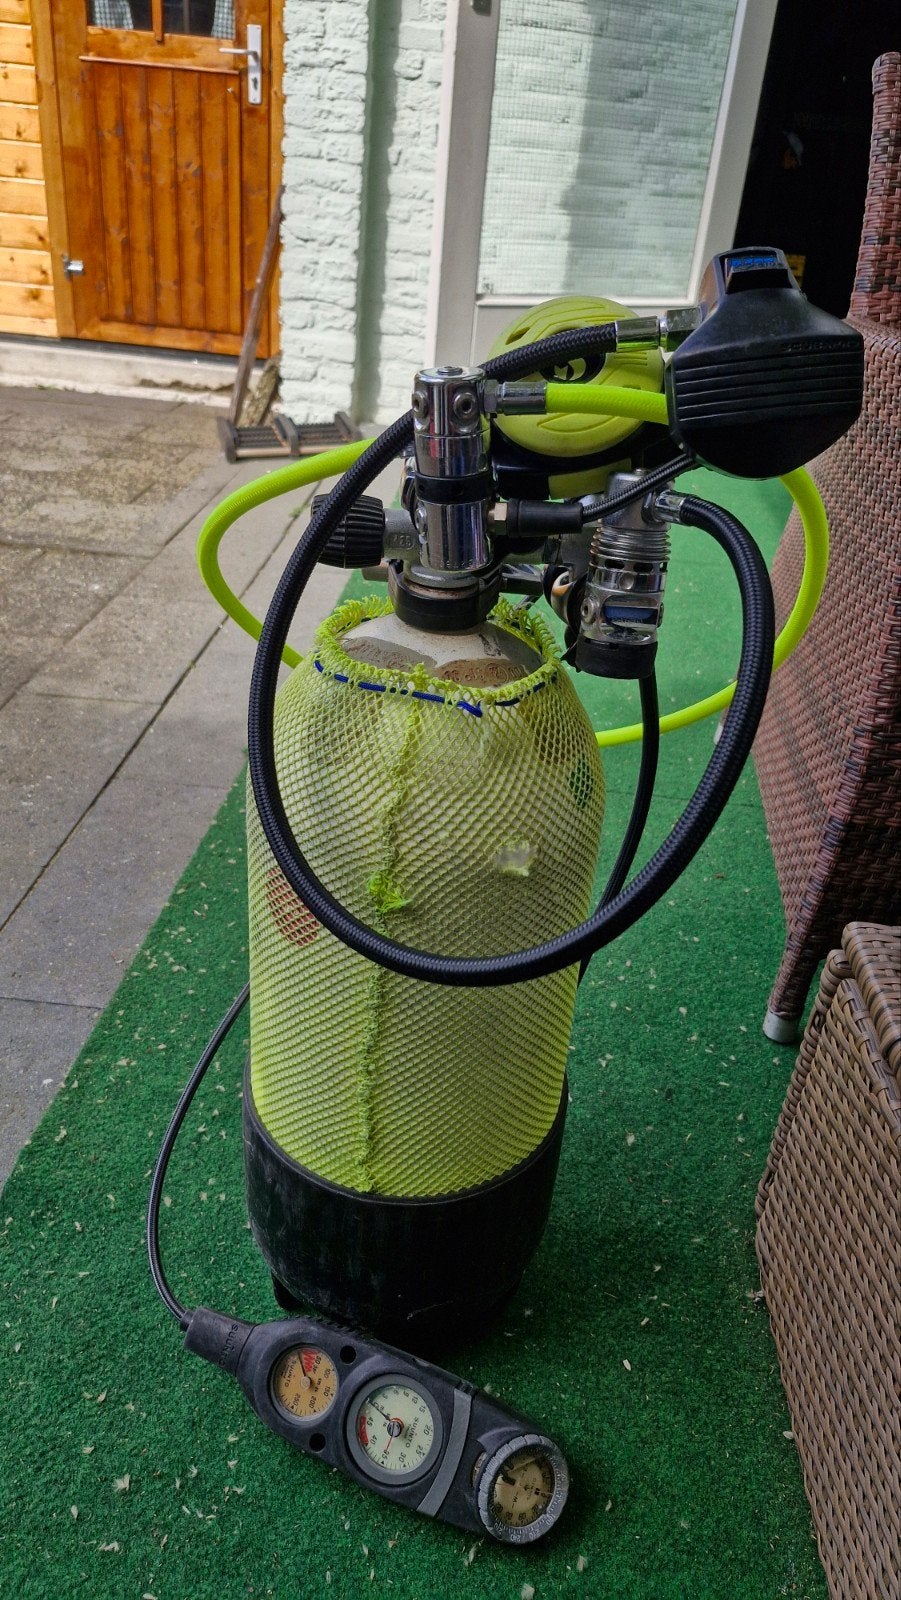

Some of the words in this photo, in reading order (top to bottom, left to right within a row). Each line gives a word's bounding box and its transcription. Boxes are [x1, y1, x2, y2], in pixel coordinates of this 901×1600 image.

[366, 1416, 374, 1426] 45
[406, 1417, 419, 1448] SUUNTO
[424, 1424, 432, 1435] 20
[370, 1434, 378, 1445] 40
[416, 1445, 424, 1455] 25
[398, 1452, 406, 1463] 30
